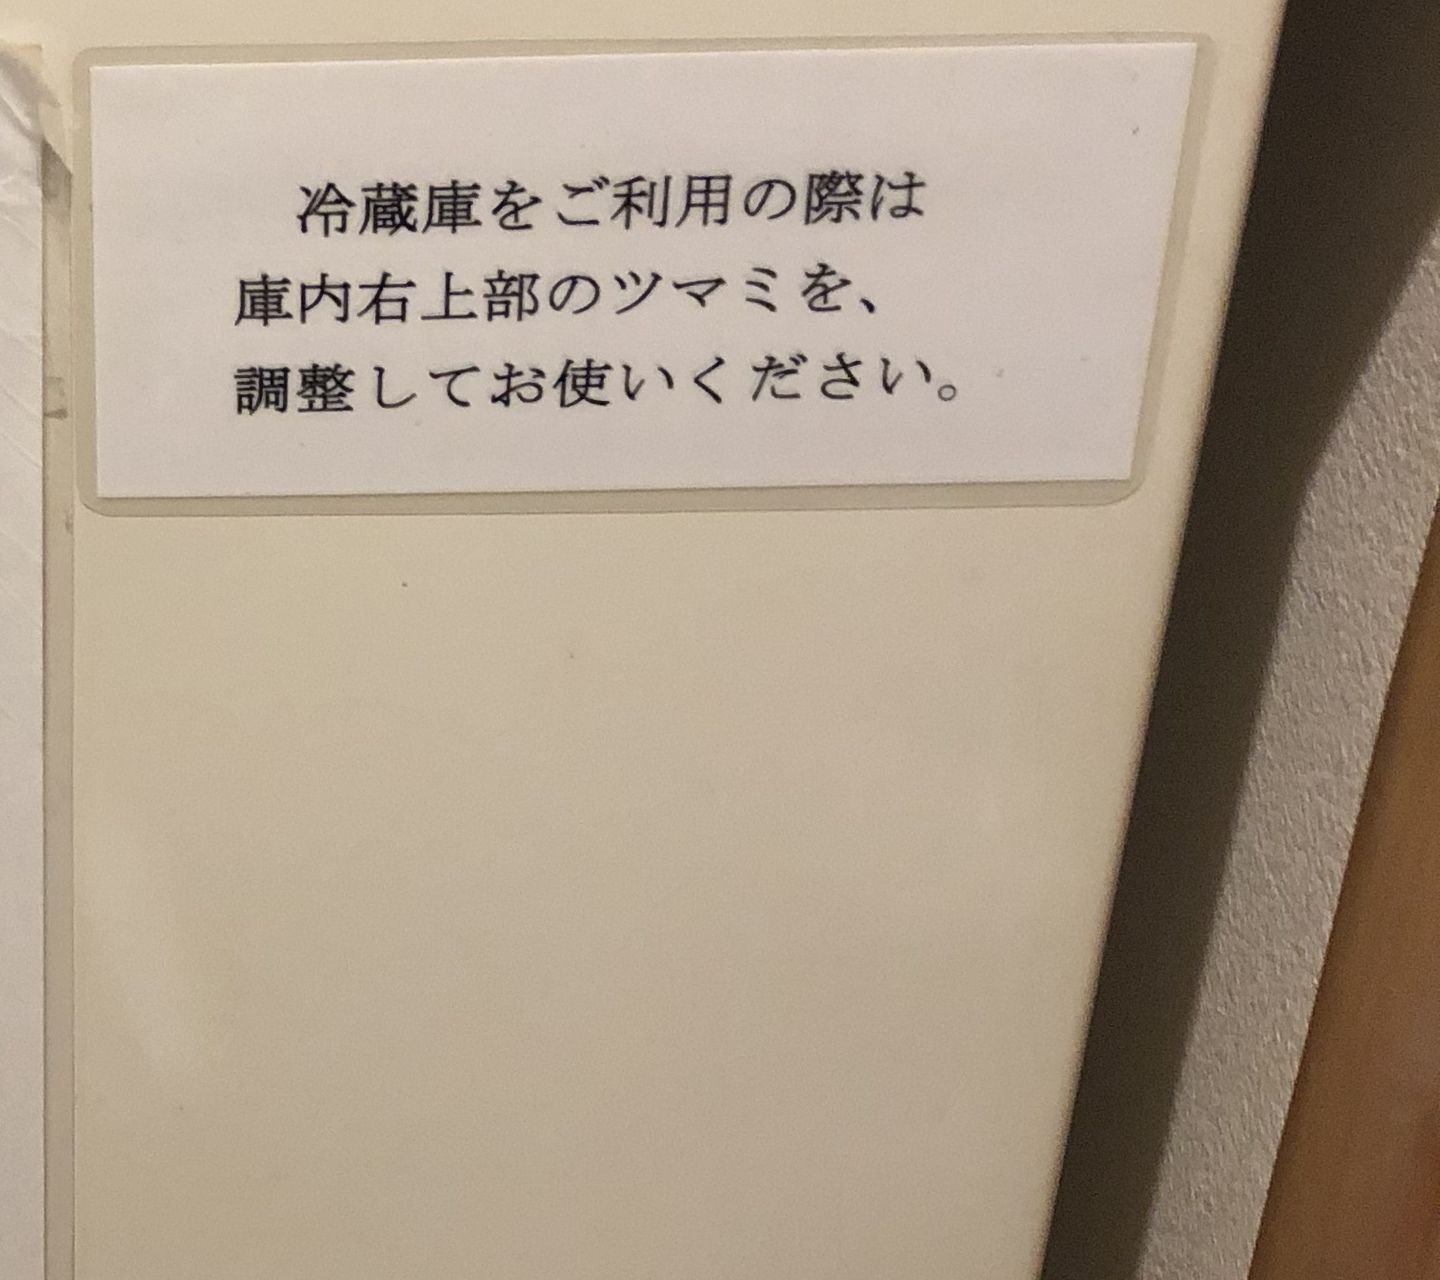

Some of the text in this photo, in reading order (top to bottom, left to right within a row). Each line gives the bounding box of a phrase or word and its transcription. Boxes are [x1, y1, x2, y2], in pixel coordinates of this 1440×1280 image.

[297, 170, 927, 237] 冷蔵庫をご利用の際は
[233, 262, 879, 327] 庫内右上部のツマミを、
[233, 352, 961, 416] 調整してお使いください。
